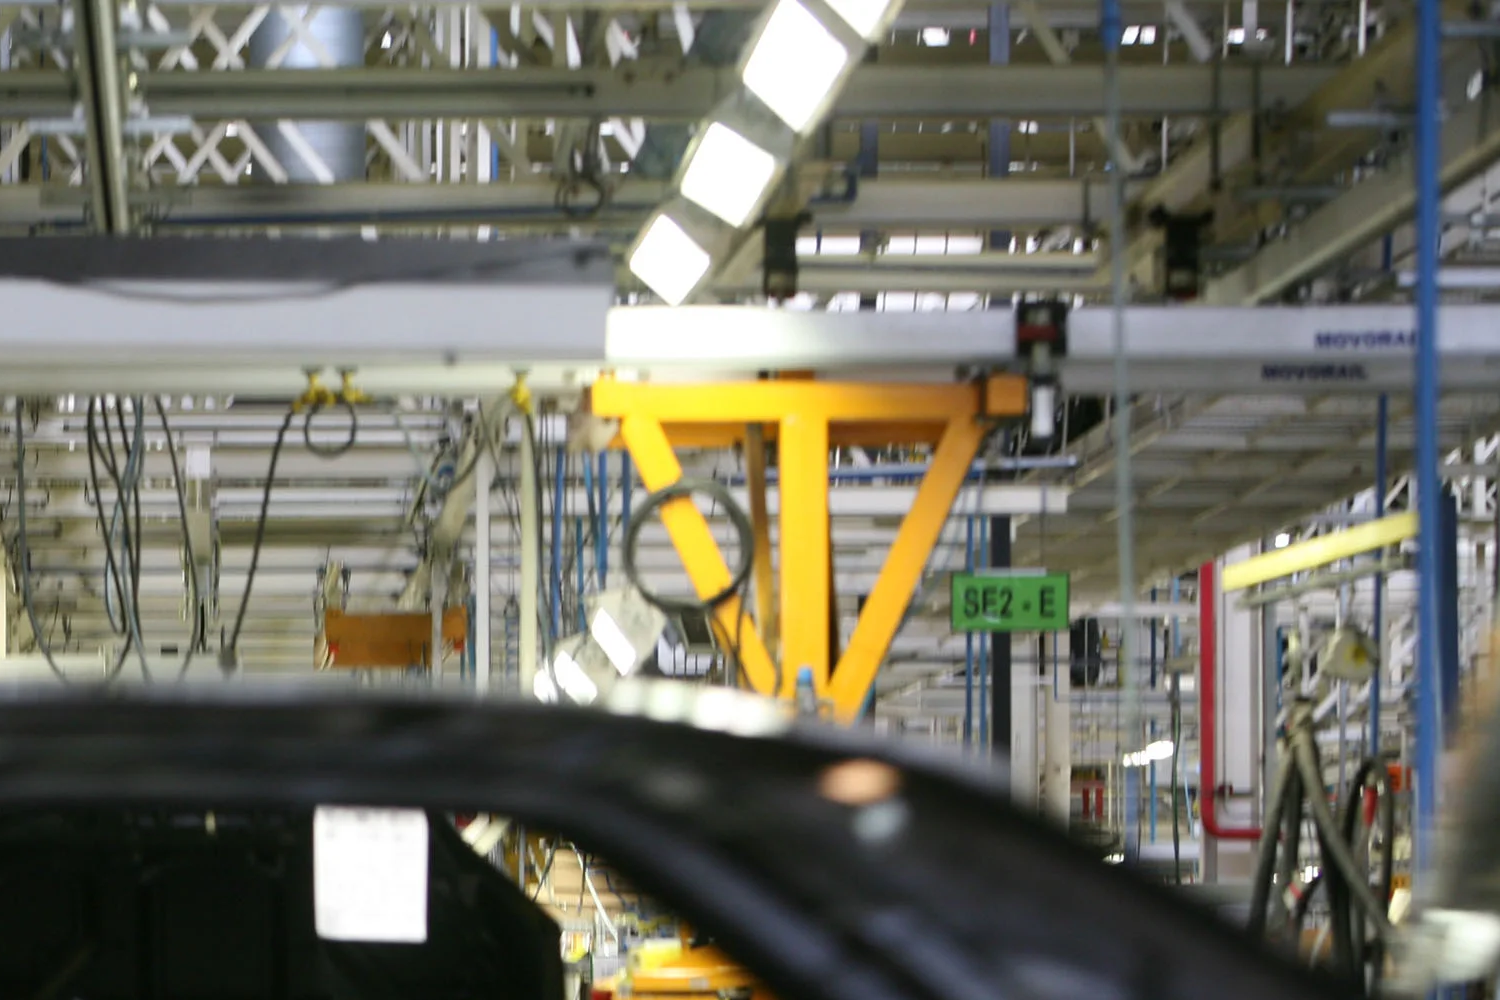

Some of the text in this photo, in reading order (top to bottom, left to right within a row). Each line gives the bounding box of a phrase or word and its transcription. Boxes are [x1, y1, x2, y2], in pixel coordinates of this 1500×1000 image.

[1315, 330, 1418, 348] MOVORAI
[964, 586, 1014, 619] SE2
[1039, 586, 1056, 618] E
